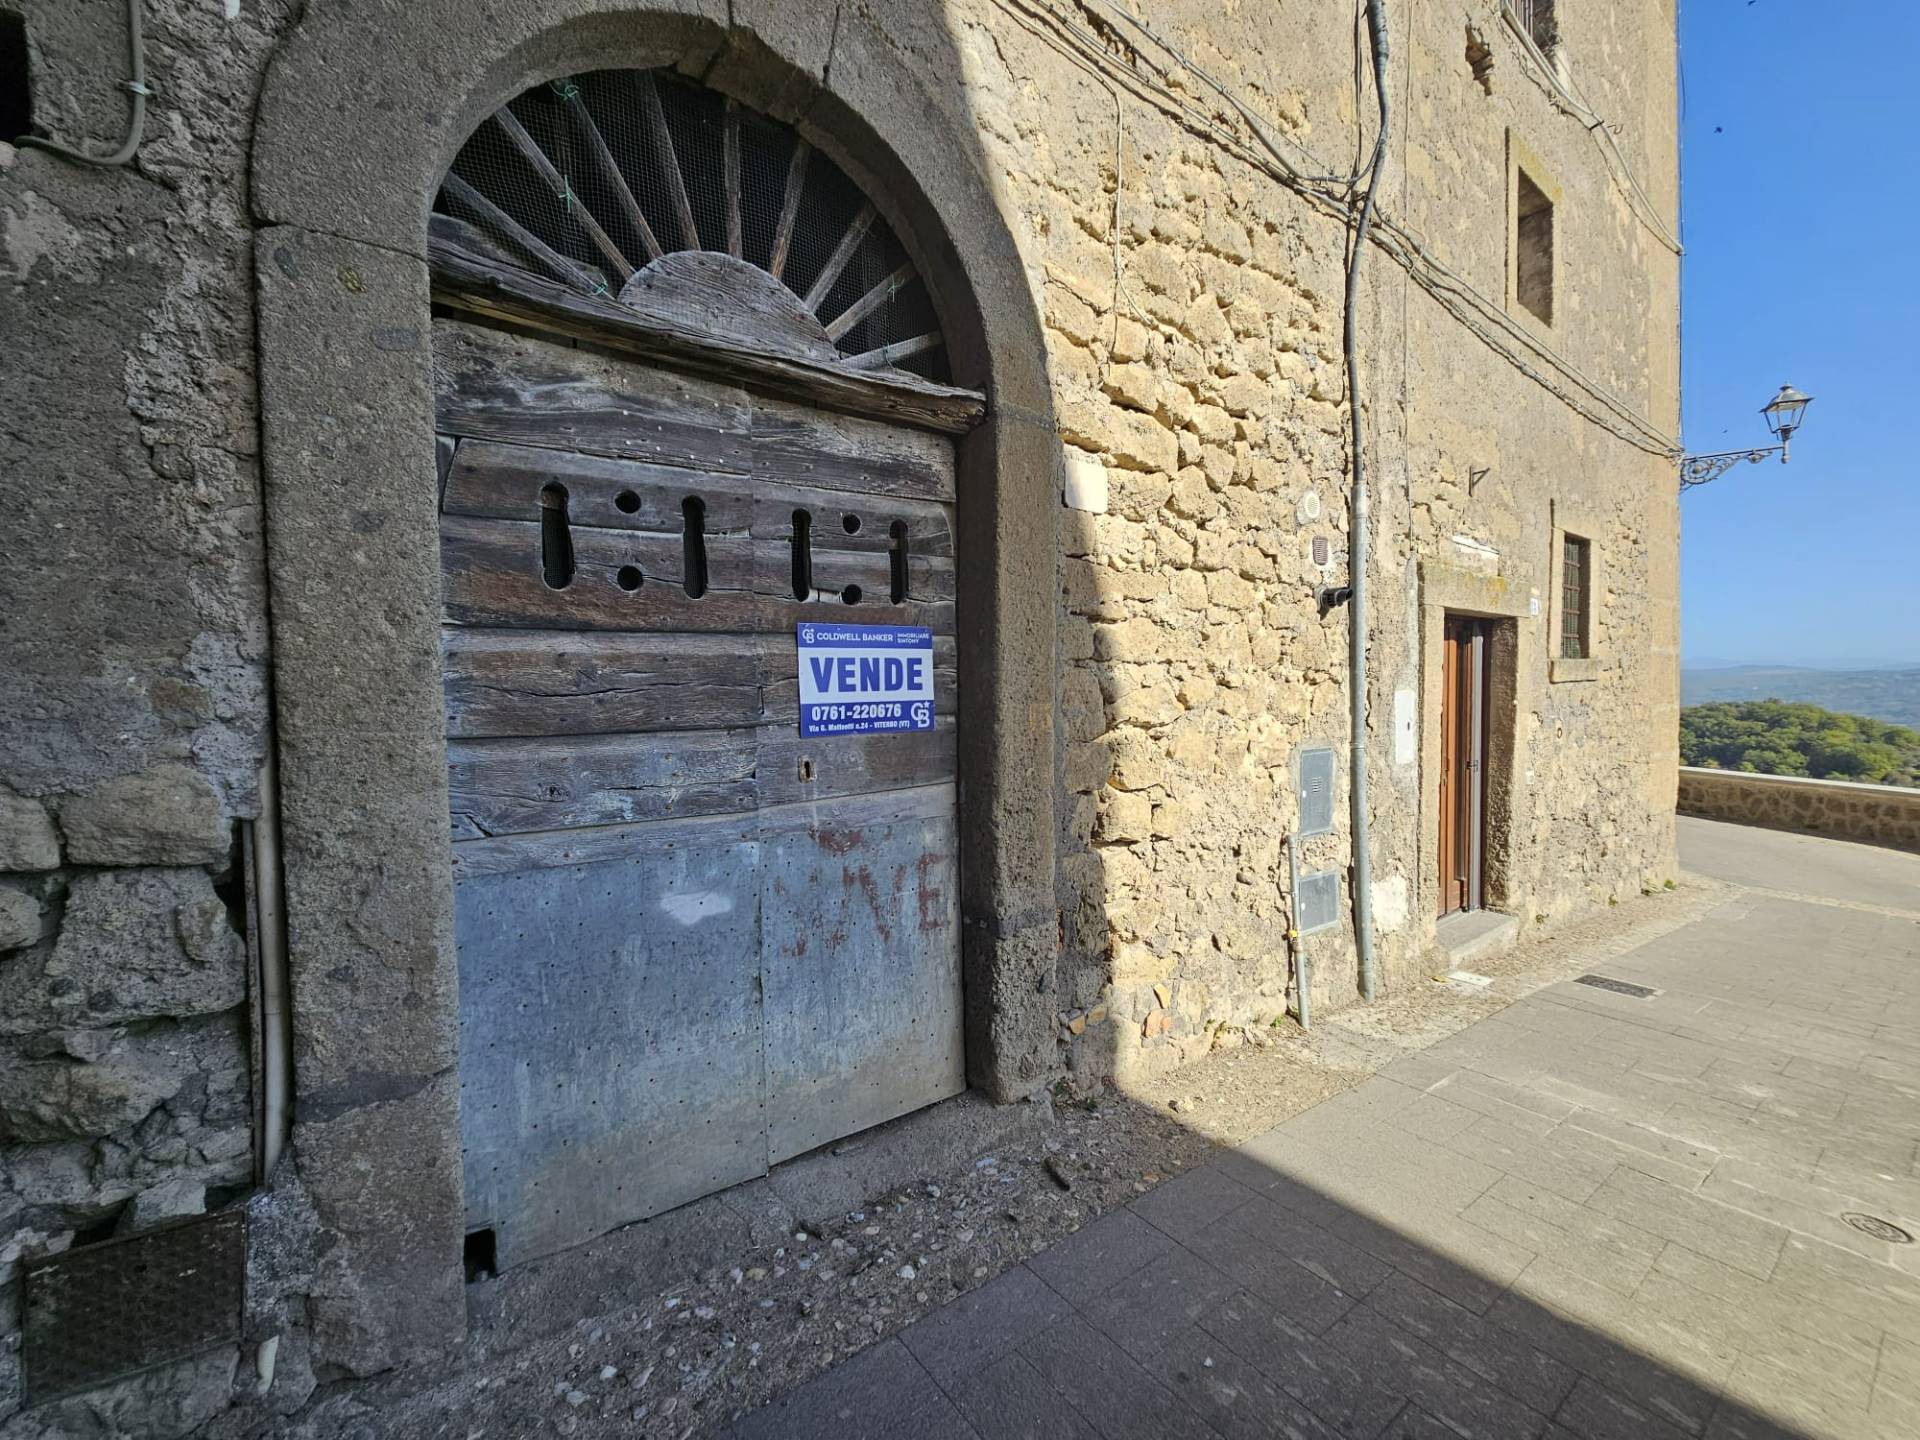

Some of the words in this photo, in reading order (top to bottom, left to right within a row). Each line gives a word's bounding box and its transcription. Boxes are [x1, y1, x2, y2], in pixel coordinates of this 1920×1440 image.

[816, 632, 861, 641] COLDWELL
[862, 633, 894, 642] BANKER
[809, 656, 924, 694] VENDE
[811, 703, 902, 721] 0761-220676
[808, 725, 820, 733] Via
[873, 720, 898, 729] VITERBO
[898, 720, 910, 728] (VT)
